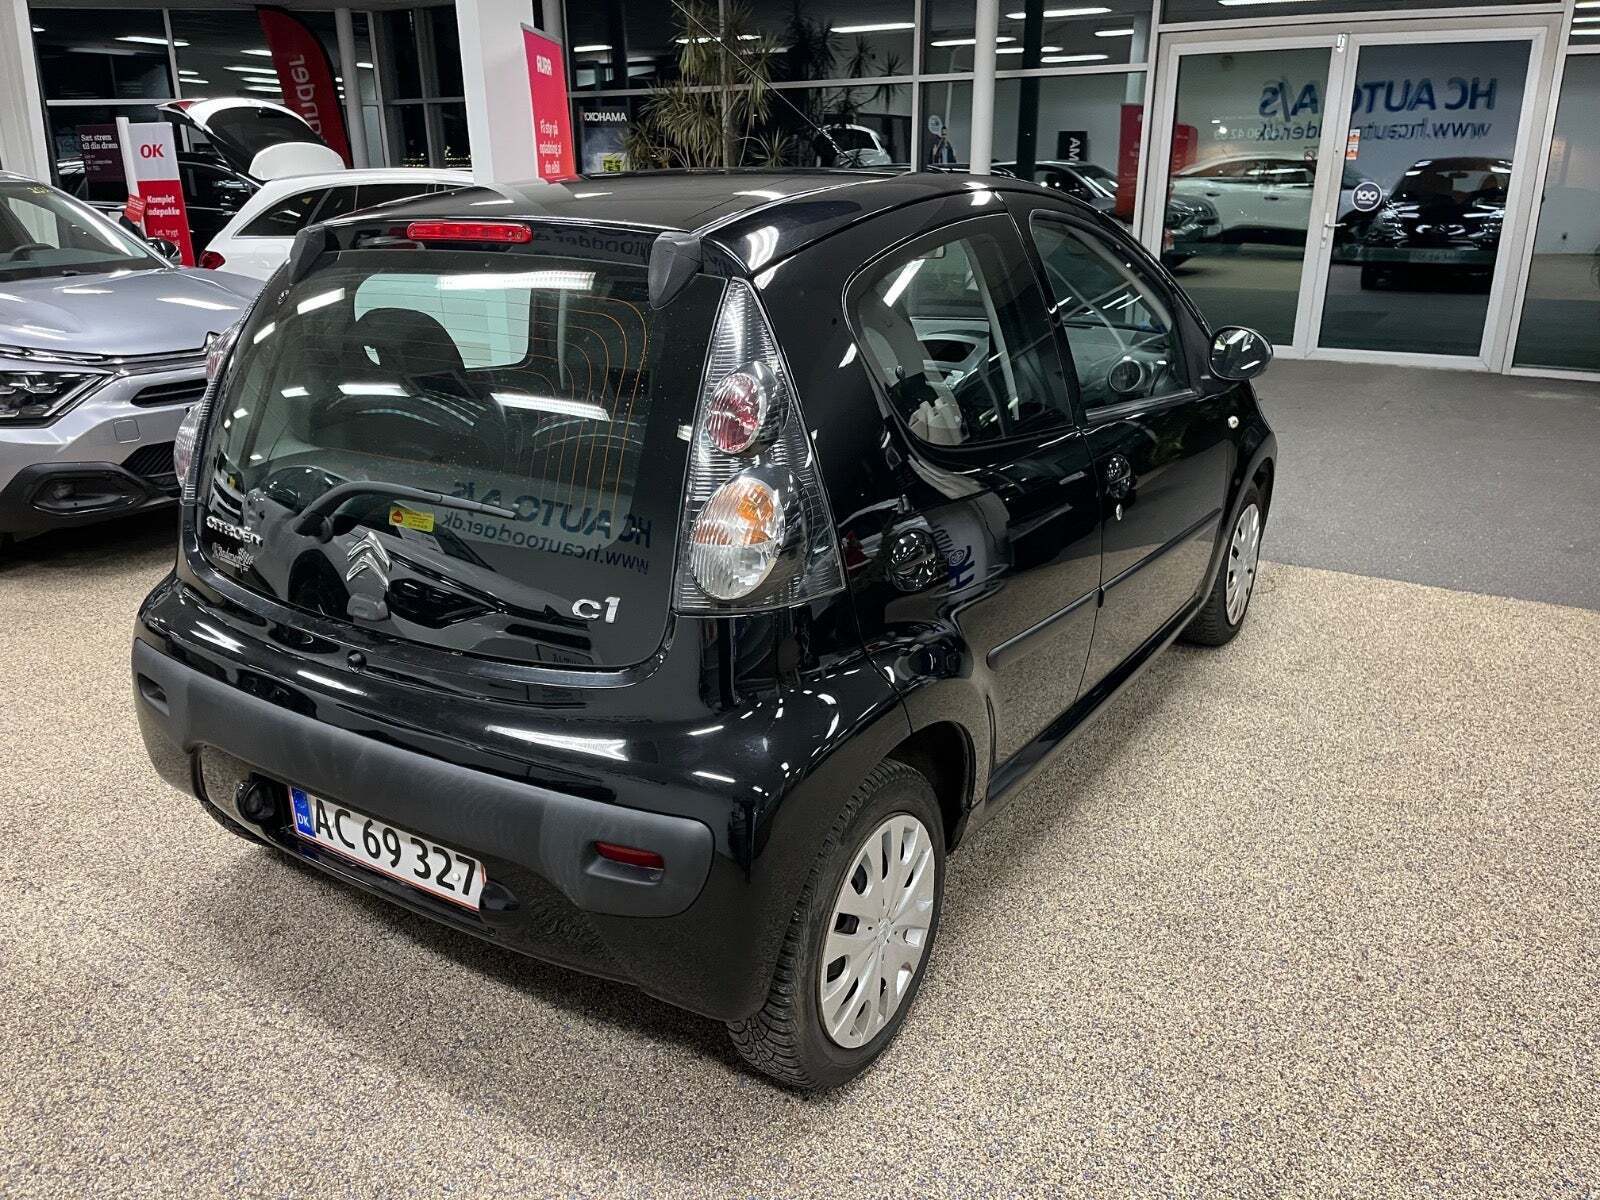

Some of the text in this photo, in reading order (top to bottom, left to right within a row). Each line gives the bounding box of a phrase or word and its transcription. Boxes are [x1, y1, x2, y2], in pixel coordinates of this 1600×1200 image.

[583, 112, 628, 122] OKOHAMA
[140, 144, 164, 159] OK
[147, 195, 175, 207] Komplet
[297, 812, 310, 828] DK
[315, 798, 477, 896] AC 69 327
